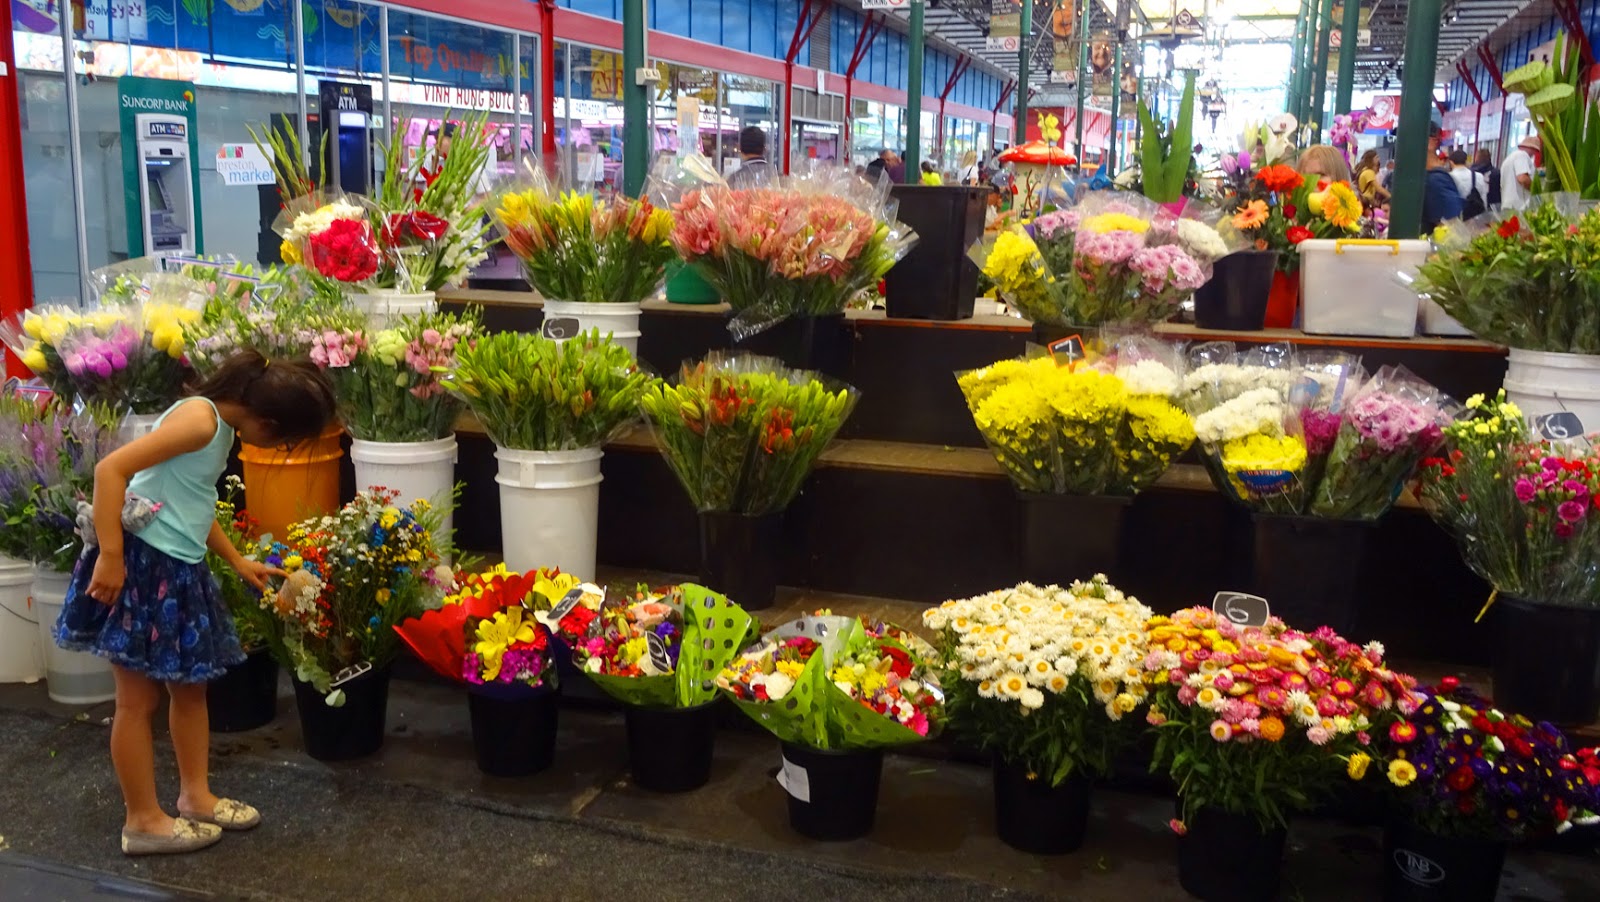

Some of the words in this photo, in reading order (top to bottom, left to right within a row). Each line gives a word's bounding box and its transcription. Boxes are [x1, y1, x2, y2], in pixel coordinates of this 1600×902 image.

[401, 37, 433, 71] Top
[122, 94, 163, 109] SUNCORP
[165, 100, 188, 111] BANK
[338, 95, 358, 110] ATM
[424, 84, 450, 104] VINH
[457, 87, 484, 108] HUNG
[151, 123, 166, 133] ATM
[218, 160, 255, 171] preston
[229, 168, 275, 182] market
[1545, 414, 1568, 438] 6
[1225, 595, 1249, 623] 6
